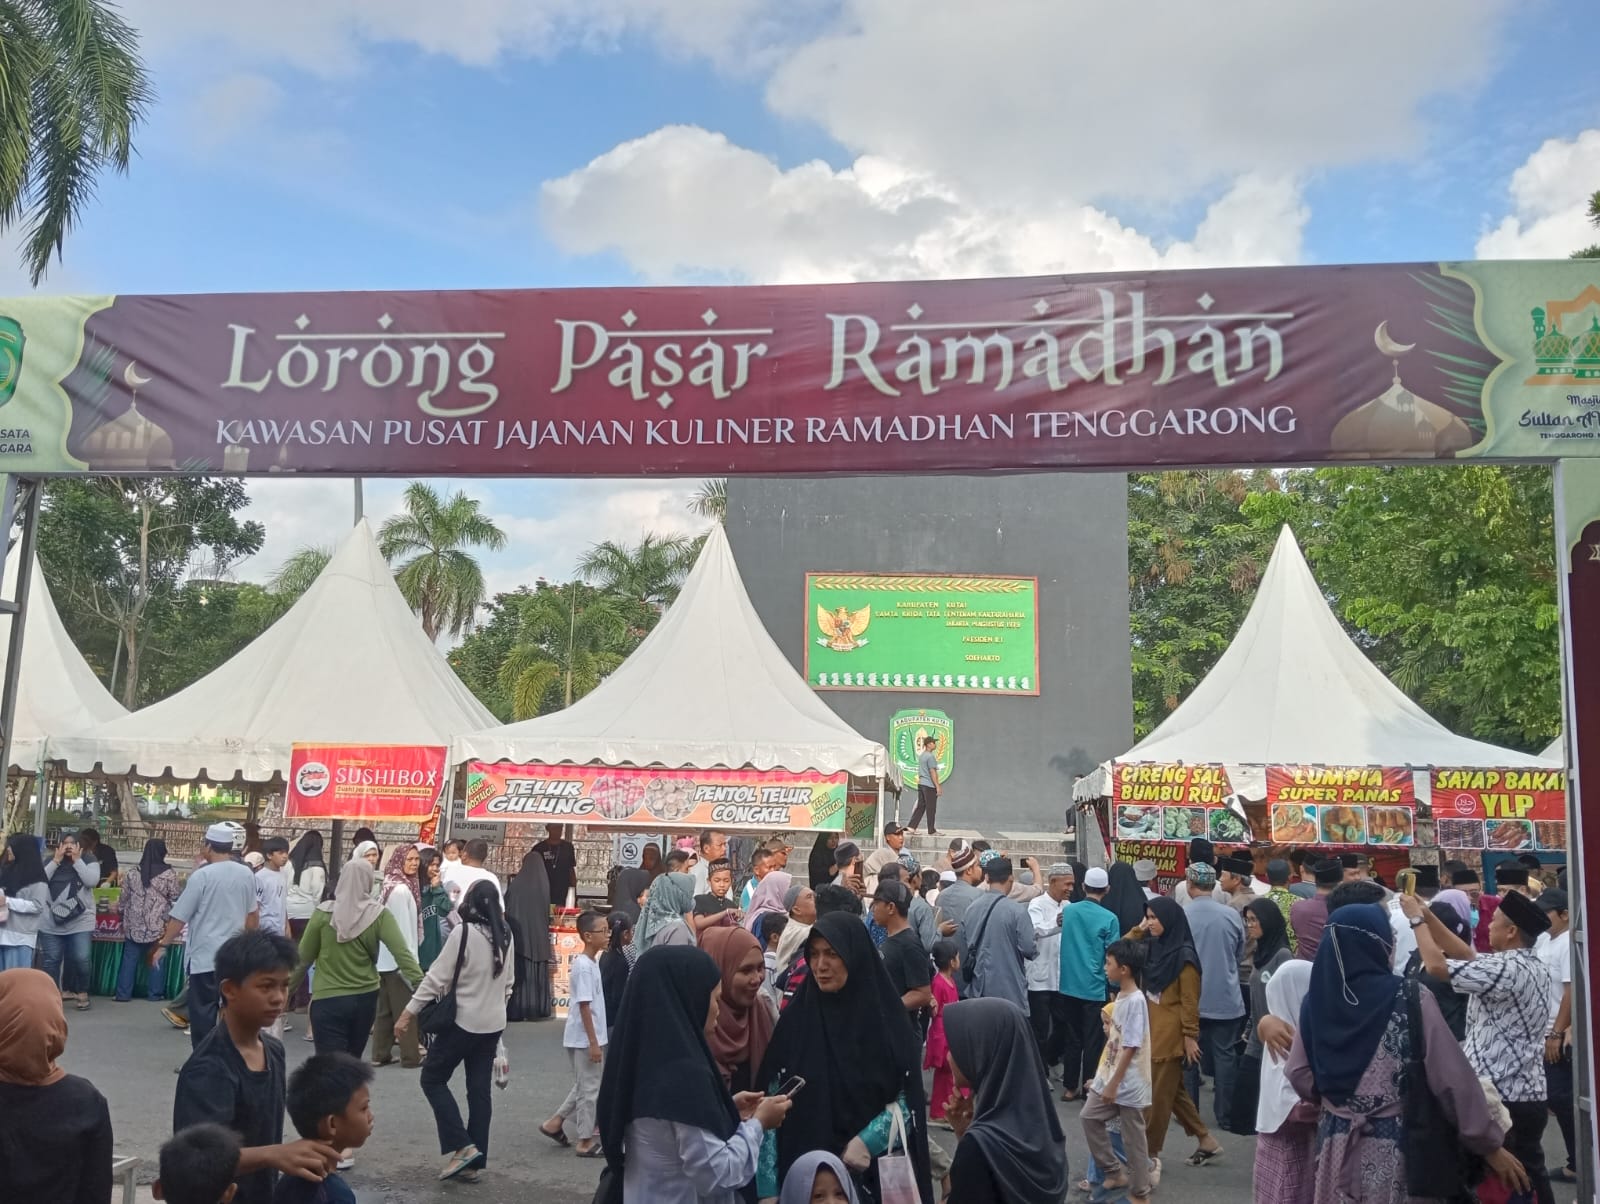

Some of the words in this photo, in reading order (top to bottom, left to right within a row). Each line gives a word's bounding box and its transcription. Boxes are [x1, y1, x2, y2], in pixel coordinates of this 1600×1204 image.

[221, 313, 505, 418] Lorong
[551, 309, 773, 409] Pasar
[824, 288, 1294, 397] Ramadhan
[216, 420, 373, 445] KAWASAN
[383, 420, 488, 446] PUSAT
[494, 420, 634, 450] JAJANAN
[645, 416, 795, 445] KULINER
[806, 413, 1014, 444] RAMADHAN
[1026, 405, 1297, 440] TENGGARONG
[1519, 409, 1574, 427] Sultan
[965, 654, 1001, 662] SOEHARTO
[335, 767, 438, 787] SUSHIBOX
[1121, 766, 1188, 784] CIRENG
[1190, 767, 1226, 786] SAL
[1294, 767, 1383, 787] LUMPIA
[1435, 771, 1500, 789] SAYAP
[504, 779, 585, 796] TELUR
[694, 785, 756, 803] PENTOL
[760, 786, 814, 805] TELUR
[1121, 784, 1185, 801] BUMBU
[1278, 787, 1338, 801] SUPER
[1343, 788, 1402, 802] PANAS
[487, 796, 596, 815] GULUNG
[711, 805, 790, 824] CONGKEL
[1479, 793, 1534, 818] YLP
[1142, 844, 1177, 858] SALJU
